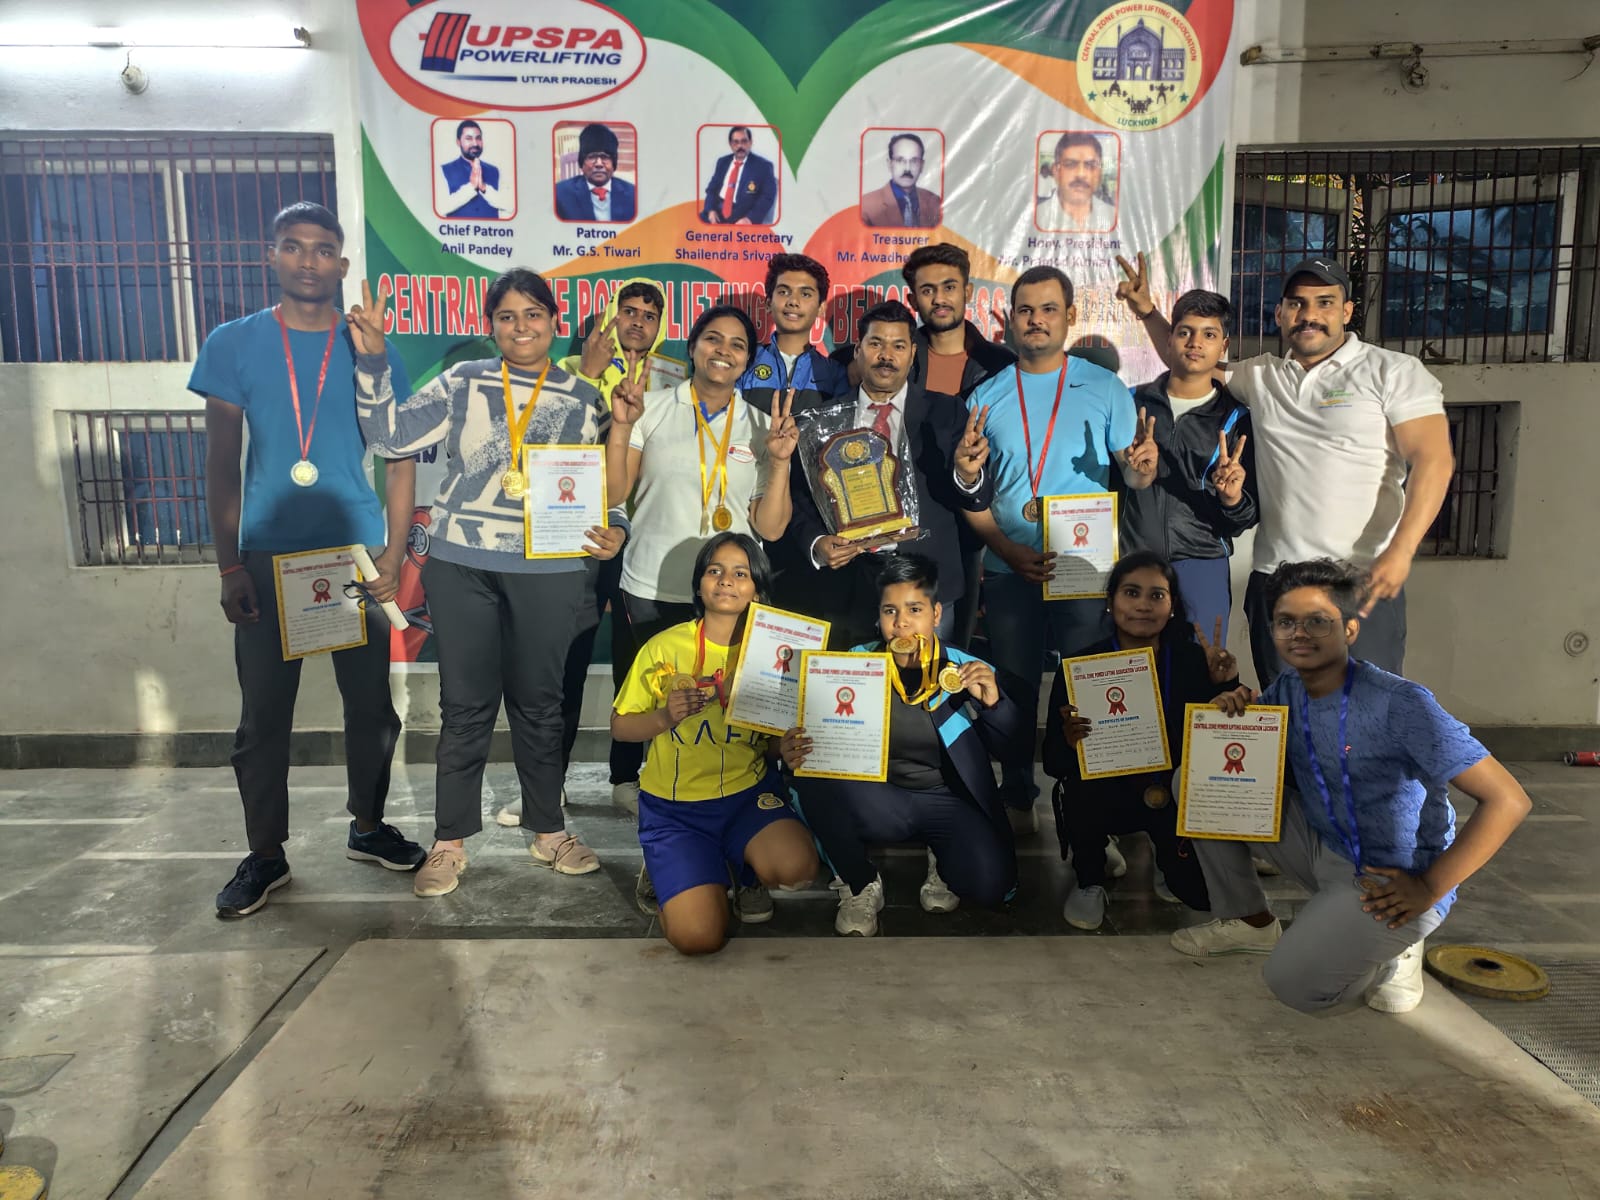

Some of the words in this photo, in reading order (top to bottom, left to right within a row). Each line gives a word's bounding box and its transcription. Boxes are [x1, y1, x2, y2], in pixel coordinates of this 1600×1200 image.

[466, 25, 623, 50] UPSPA
[1081, 30, 1099, 62] CENTRAL
[1096, 12, 1115, 32] ZONE
[1115, 4, 1143, 16] POWER
[1144, 5, 1171, 19] LIFTING
[1170, 16, 1197, 62] ASSOCIATION
[459, 49, 622, 66] POWERLIFTING
[521, 76, 559, 84] UTTAR
[562, 76, 617, 86] PRADESH
[1117, 117, 1158, 128] LUCKNOW
[439, 224, 470, 237] Chief
[473, 225, 514, 238] Patron
[576, 227, 617, 239] Patron
[685, 230, 733, 242] General
[736, 231, 793, 246] Secretary
[873, 233, 929, 245] Treasurer
[1066, 237, 1120, 249] President
[441, 243, 465, 255] Anil
[468, 243, 513, 258] Pandey
[552, 245, 573, 257] Mr.
[576, 245, 600, 257] G.S.
[603, 245, 641, 257] Tiwari
[675, 248, 739, 260] Shailendra
[837, 251, 856, 262] Mr.
[861, 251, 911, 263] Awadhe
